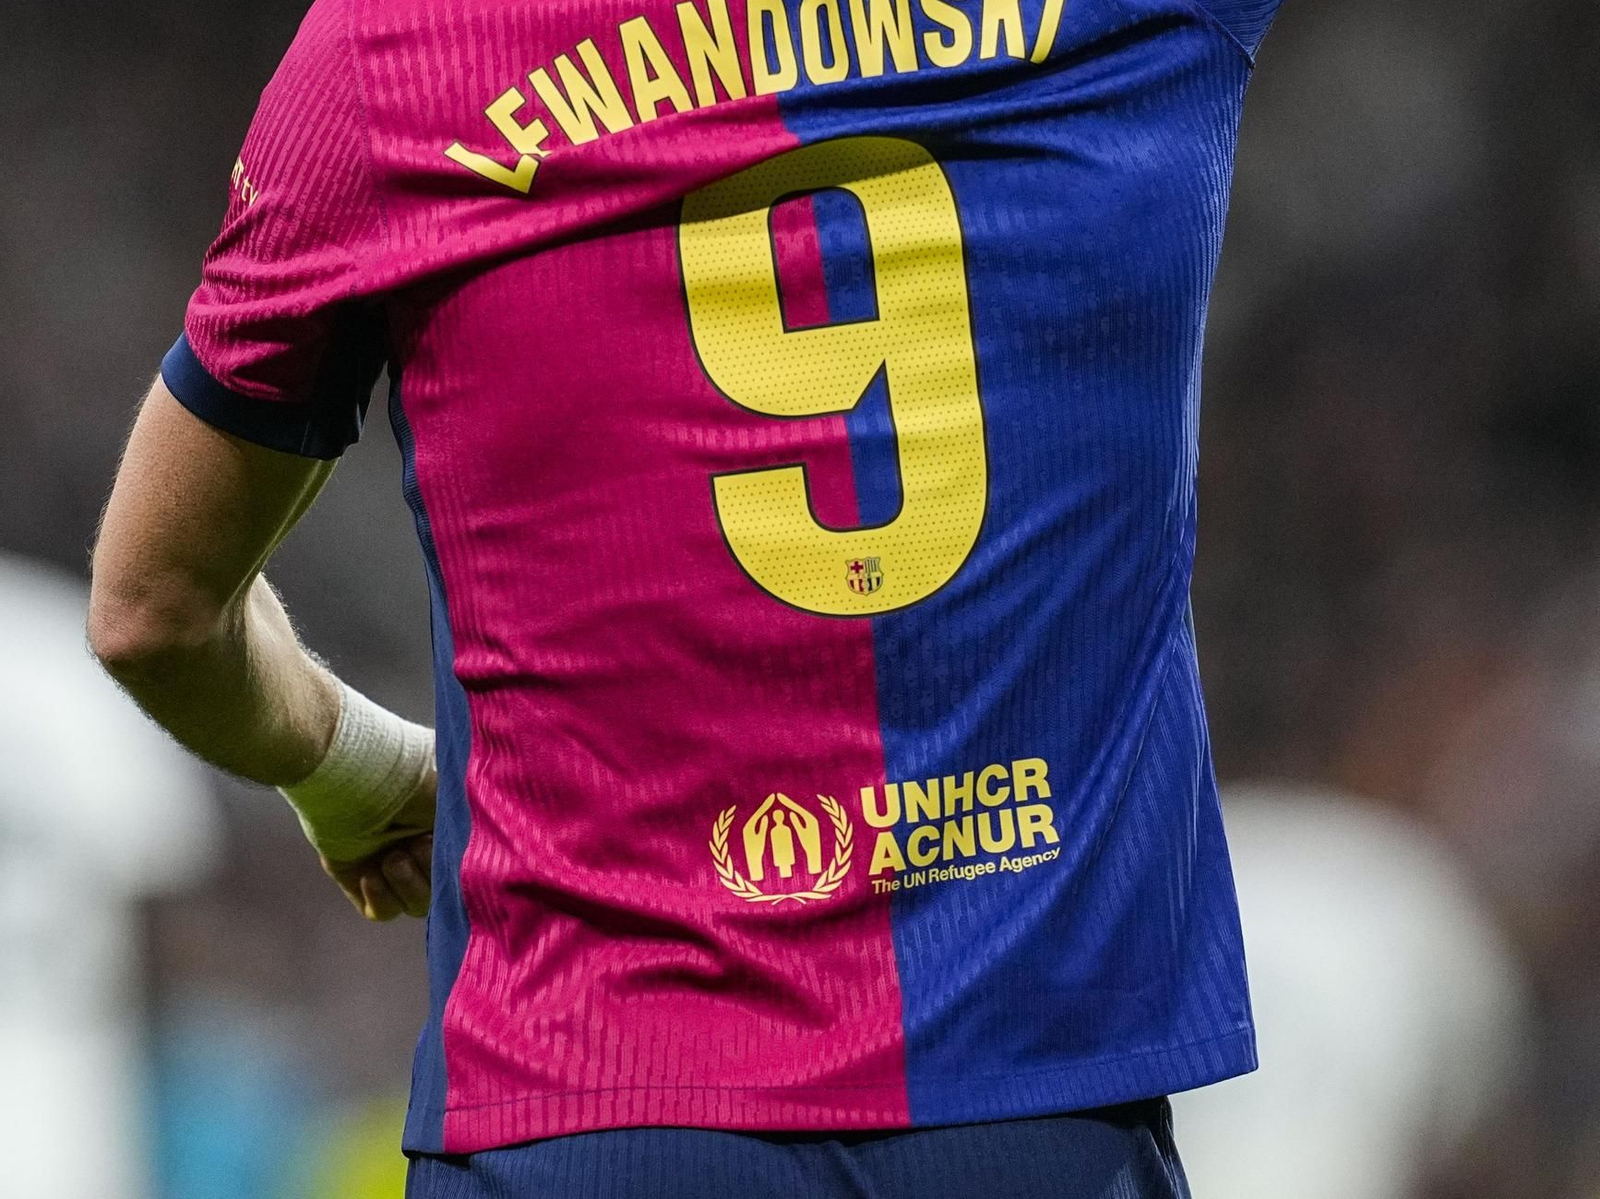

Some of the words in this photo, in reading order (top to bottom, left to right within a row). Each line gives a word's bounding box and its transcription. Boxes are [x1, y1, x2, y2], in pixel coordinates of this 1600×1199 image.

[677, 135, 988, 616] 9
[859, 757, 1051, 828] UNHCR
[868, 803, 1060, 876] ACNUR
[871, 879, 900, 894] The
[904, 871, 926, 889] UN
[928, 861, 996, 883] Refugee
[999, 847, 1060, 873] Agency
